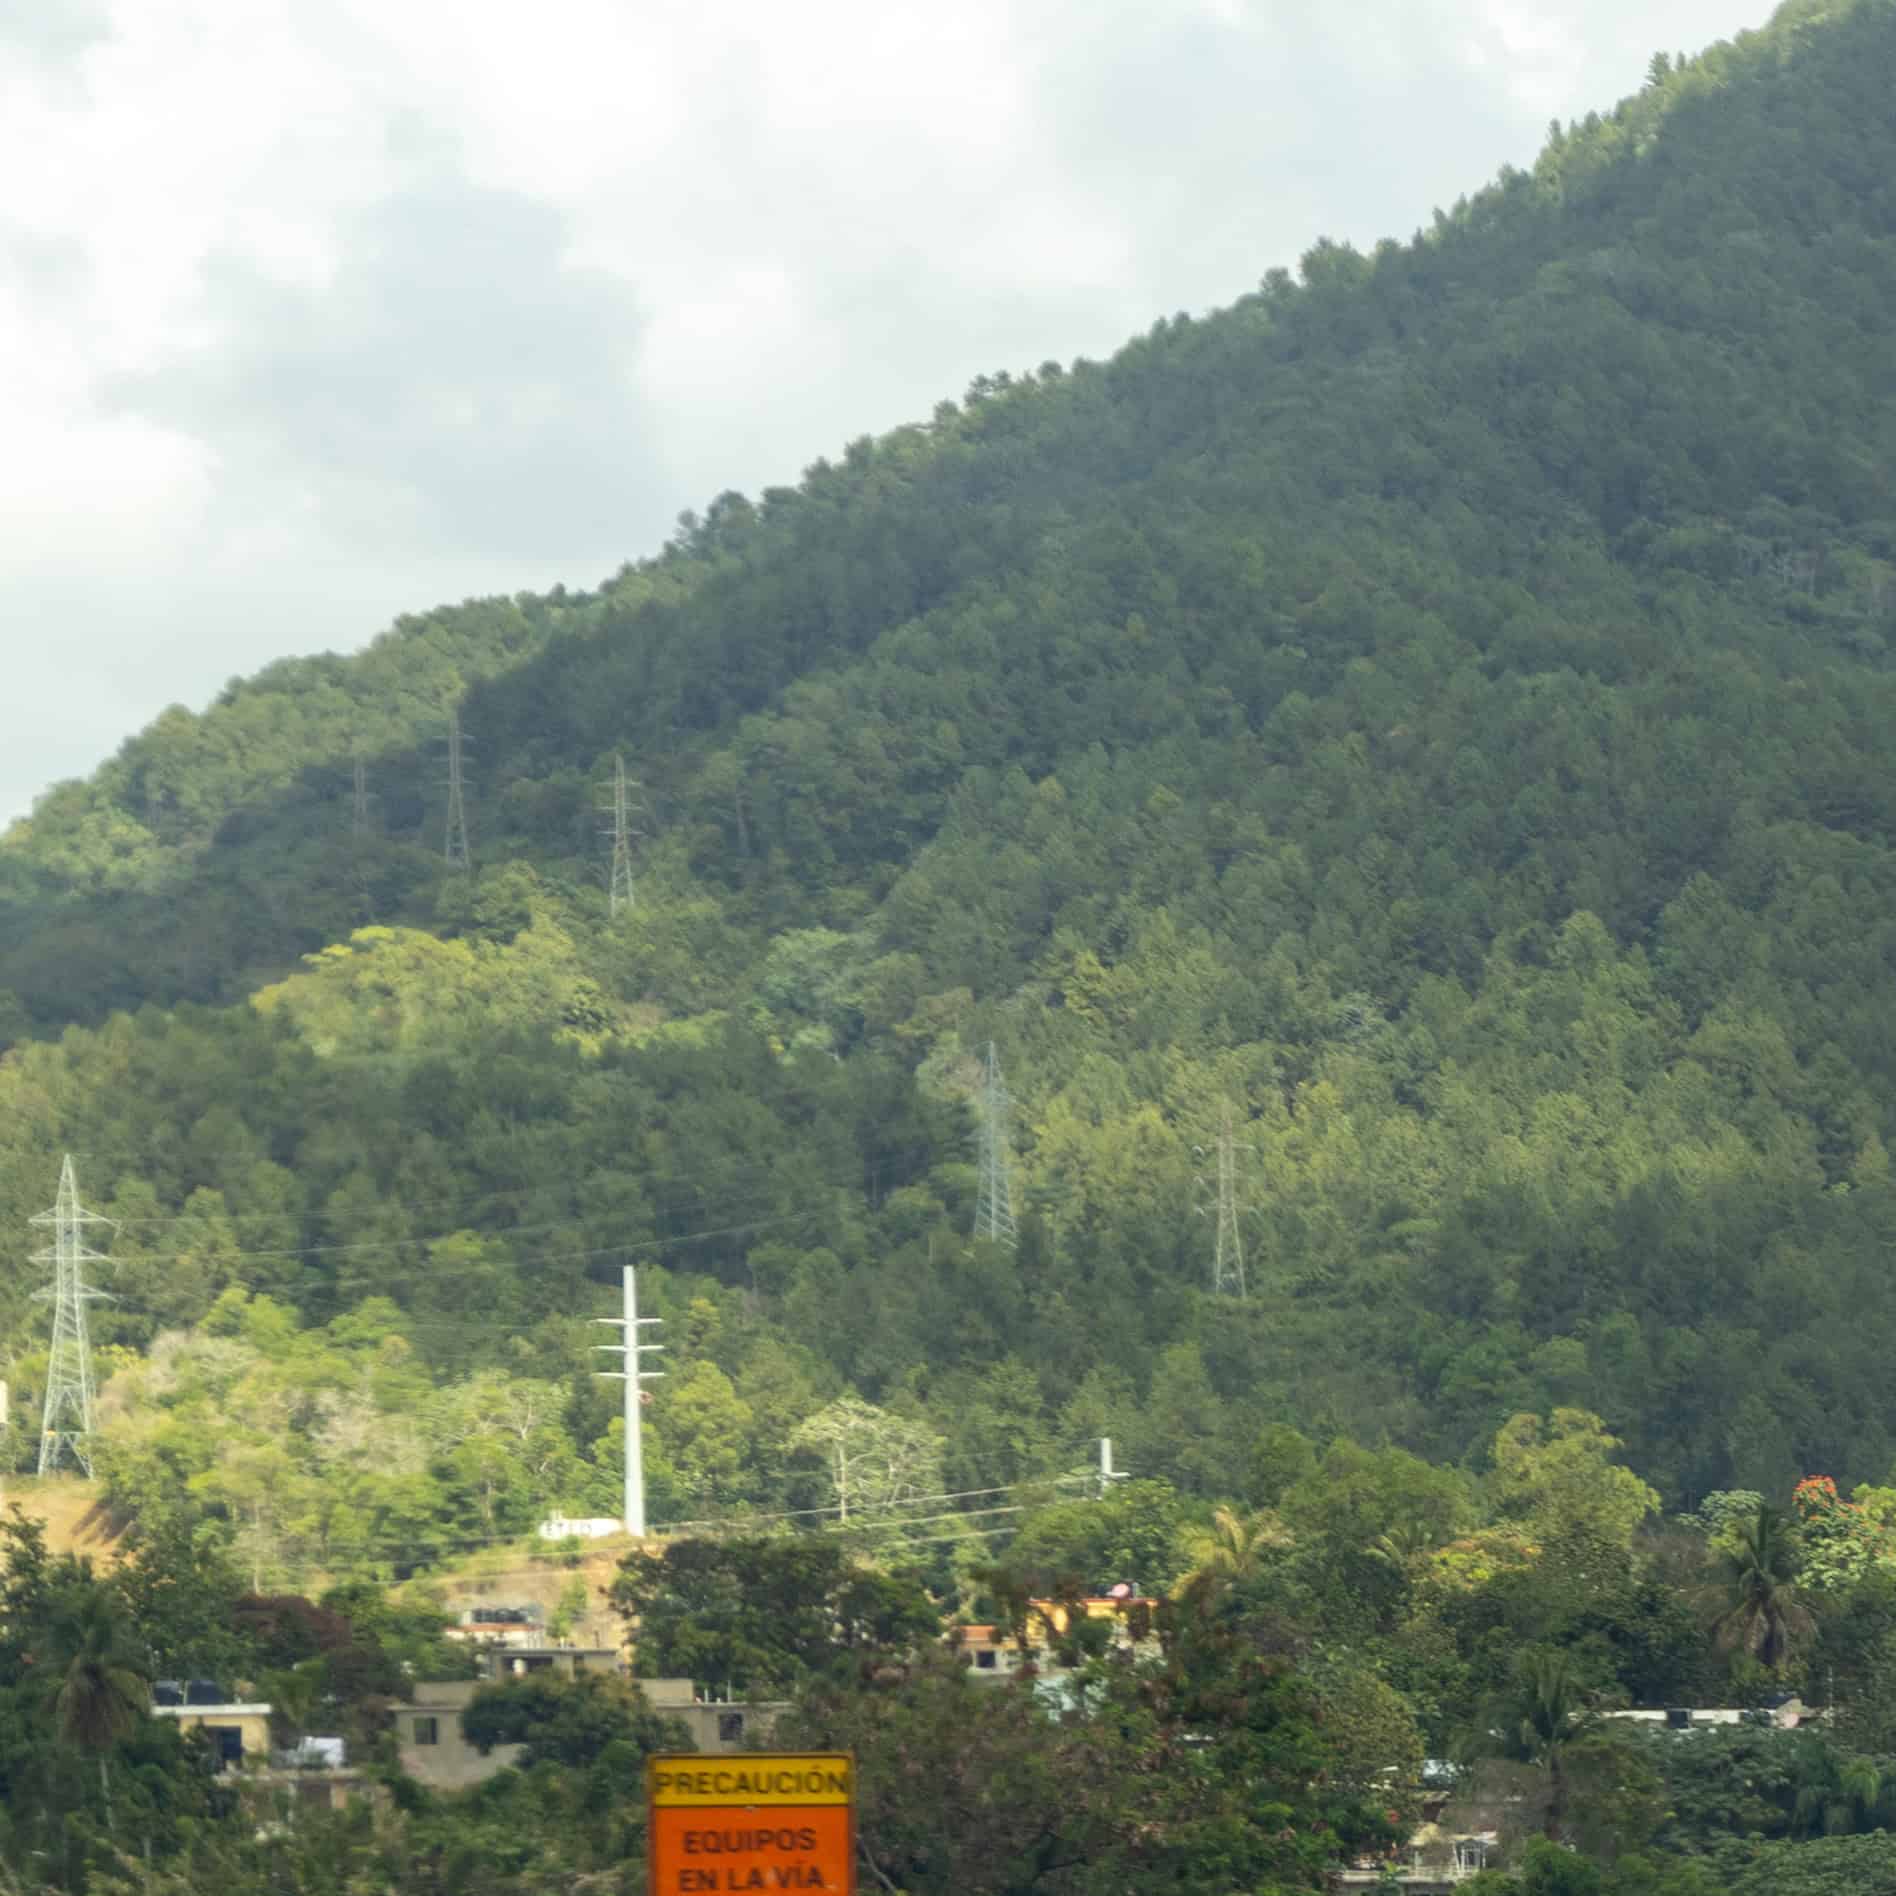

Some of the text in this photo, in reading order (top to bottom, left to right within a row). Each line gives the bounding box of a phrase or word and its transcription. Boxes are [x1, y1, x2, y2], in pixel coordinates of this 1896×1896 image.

[655, 1765, 848, 1795] PRECAUCIÓN
[683, 1828, 817, 1854] EQUIPOS
[679, 1861, 825, 1893] EN LA VÍA
